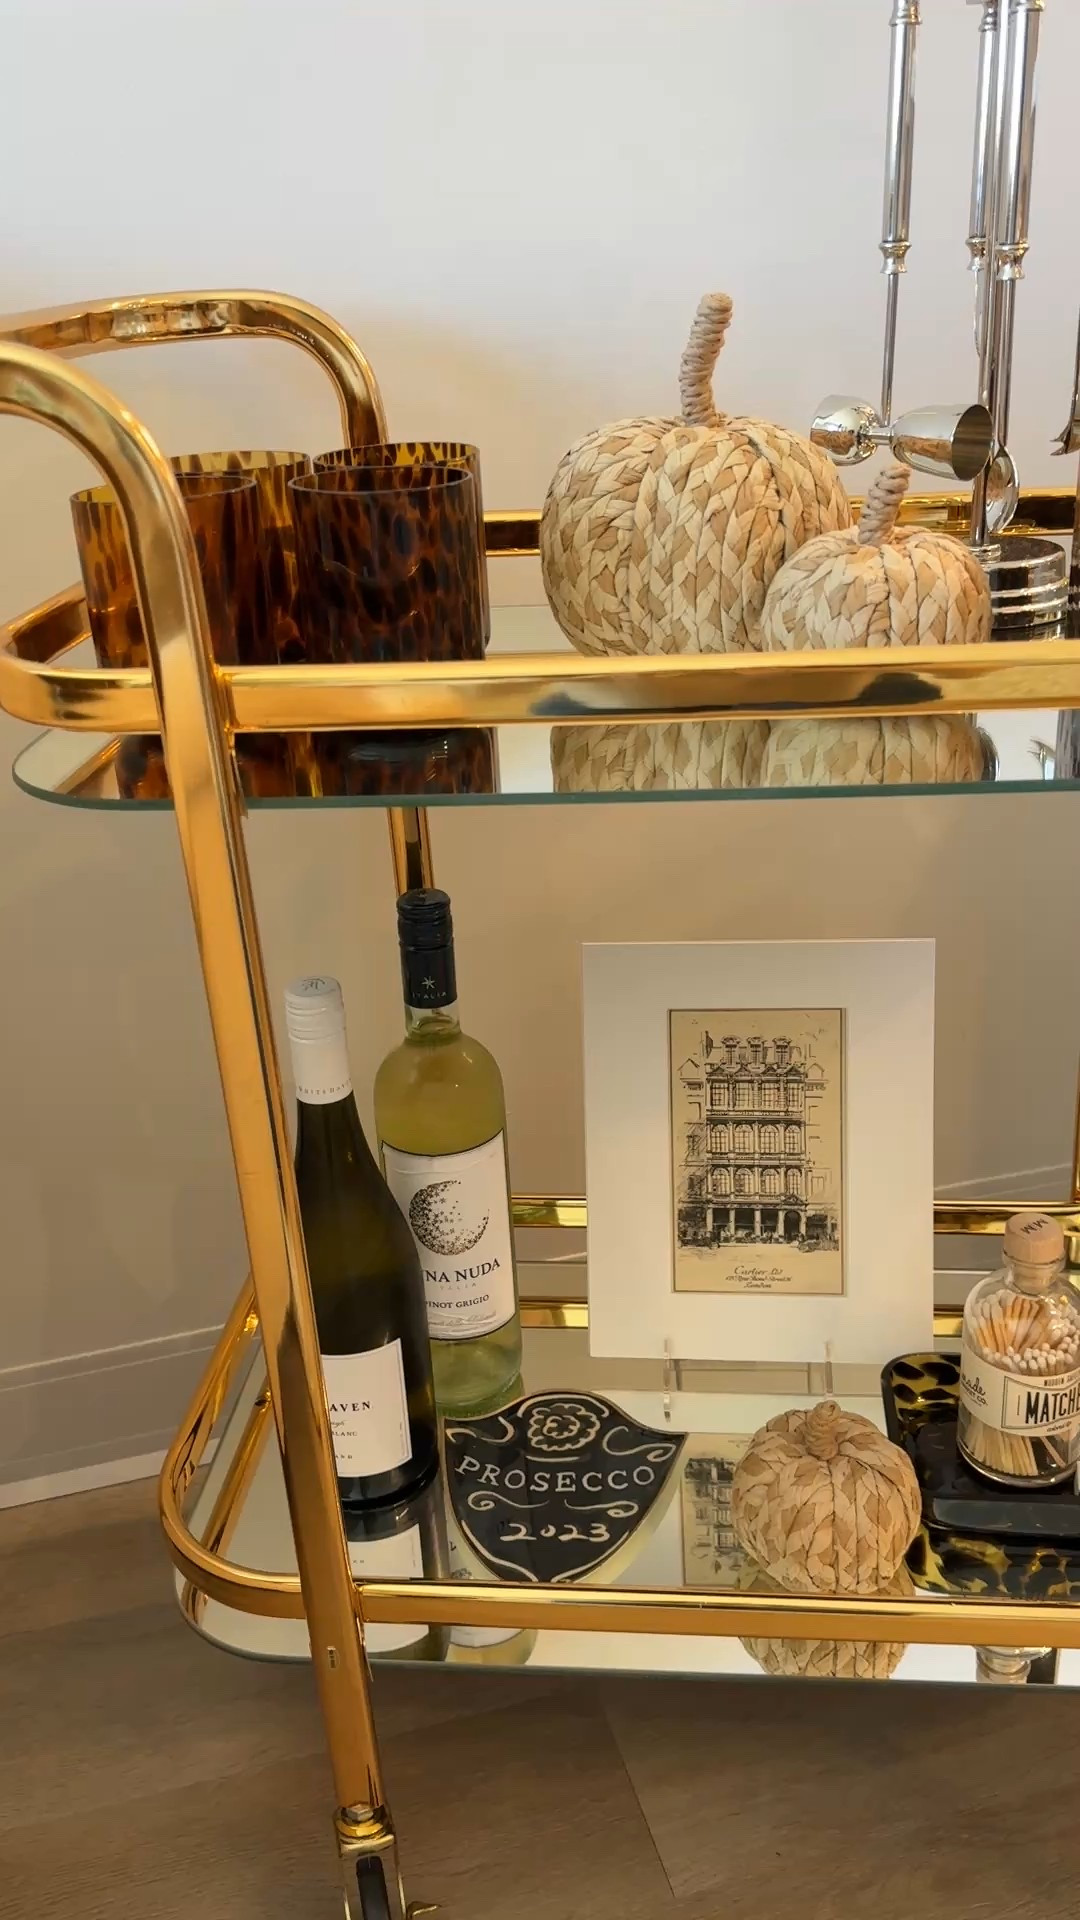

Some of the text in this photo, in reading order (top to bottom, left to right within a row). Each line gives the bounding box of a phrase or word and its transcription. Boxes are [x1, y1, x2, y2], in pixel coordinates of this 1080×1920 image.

[423, 1258, 501, 1283] NA NUDA
[440, 1282, 477, 1290] TALIA
[455, 1294, 490, 1308] GRIGIO
[329, 1400, 371, 1412] AVEN
[1025, 1382, 1080, 1425] MATCHE
[454, 1455, 655, 1492] PROSECCO
[500, 1522, 611, 1542] 2023
